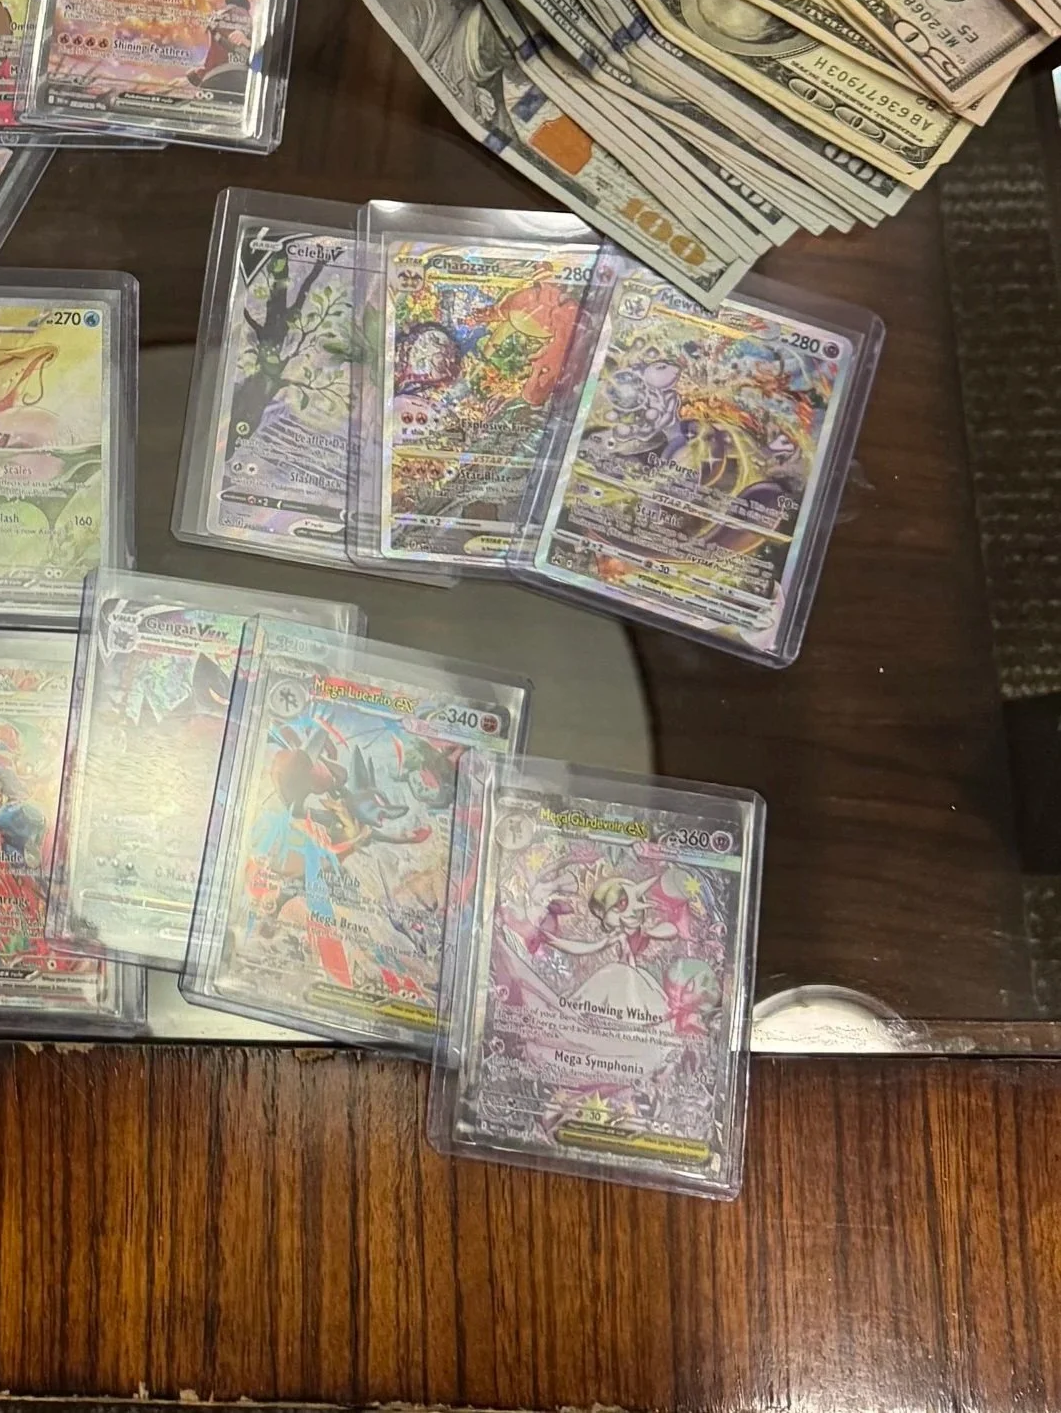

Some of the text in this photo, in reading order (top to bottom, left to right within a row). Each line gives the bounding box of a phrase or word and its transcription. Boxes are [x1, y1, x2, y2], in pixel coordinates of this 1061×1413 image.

[958, 22, 981, 45] E5
[113, 40, 190, 58] Shining Feathers
[893, 18, 964, 87] 50
[625, 196, 708, 267] 100
[562, 266, 593, 282] 280
[53, 311, 82, 327] 270
[789, 331, 821, 354] 280
[3, 464, 33, 476] Scales
[73, 515, 94, 529] 160
[146, 616, 196, 637] Gengar
[313, 677, 392, 708] Mega Lucario
[446, 707, 479, 729] 340
[540, 808, 624, 833] Mega Gardevoir
[678, 829, 710, 849] 360
[310, 911, 370, 935] Mega Brave
[558, 996, 624, 1020] Overflowing
[626, 1006, 664, 1024] Wishes
[554, 1049, 645, 1076] Mega Symphonia
